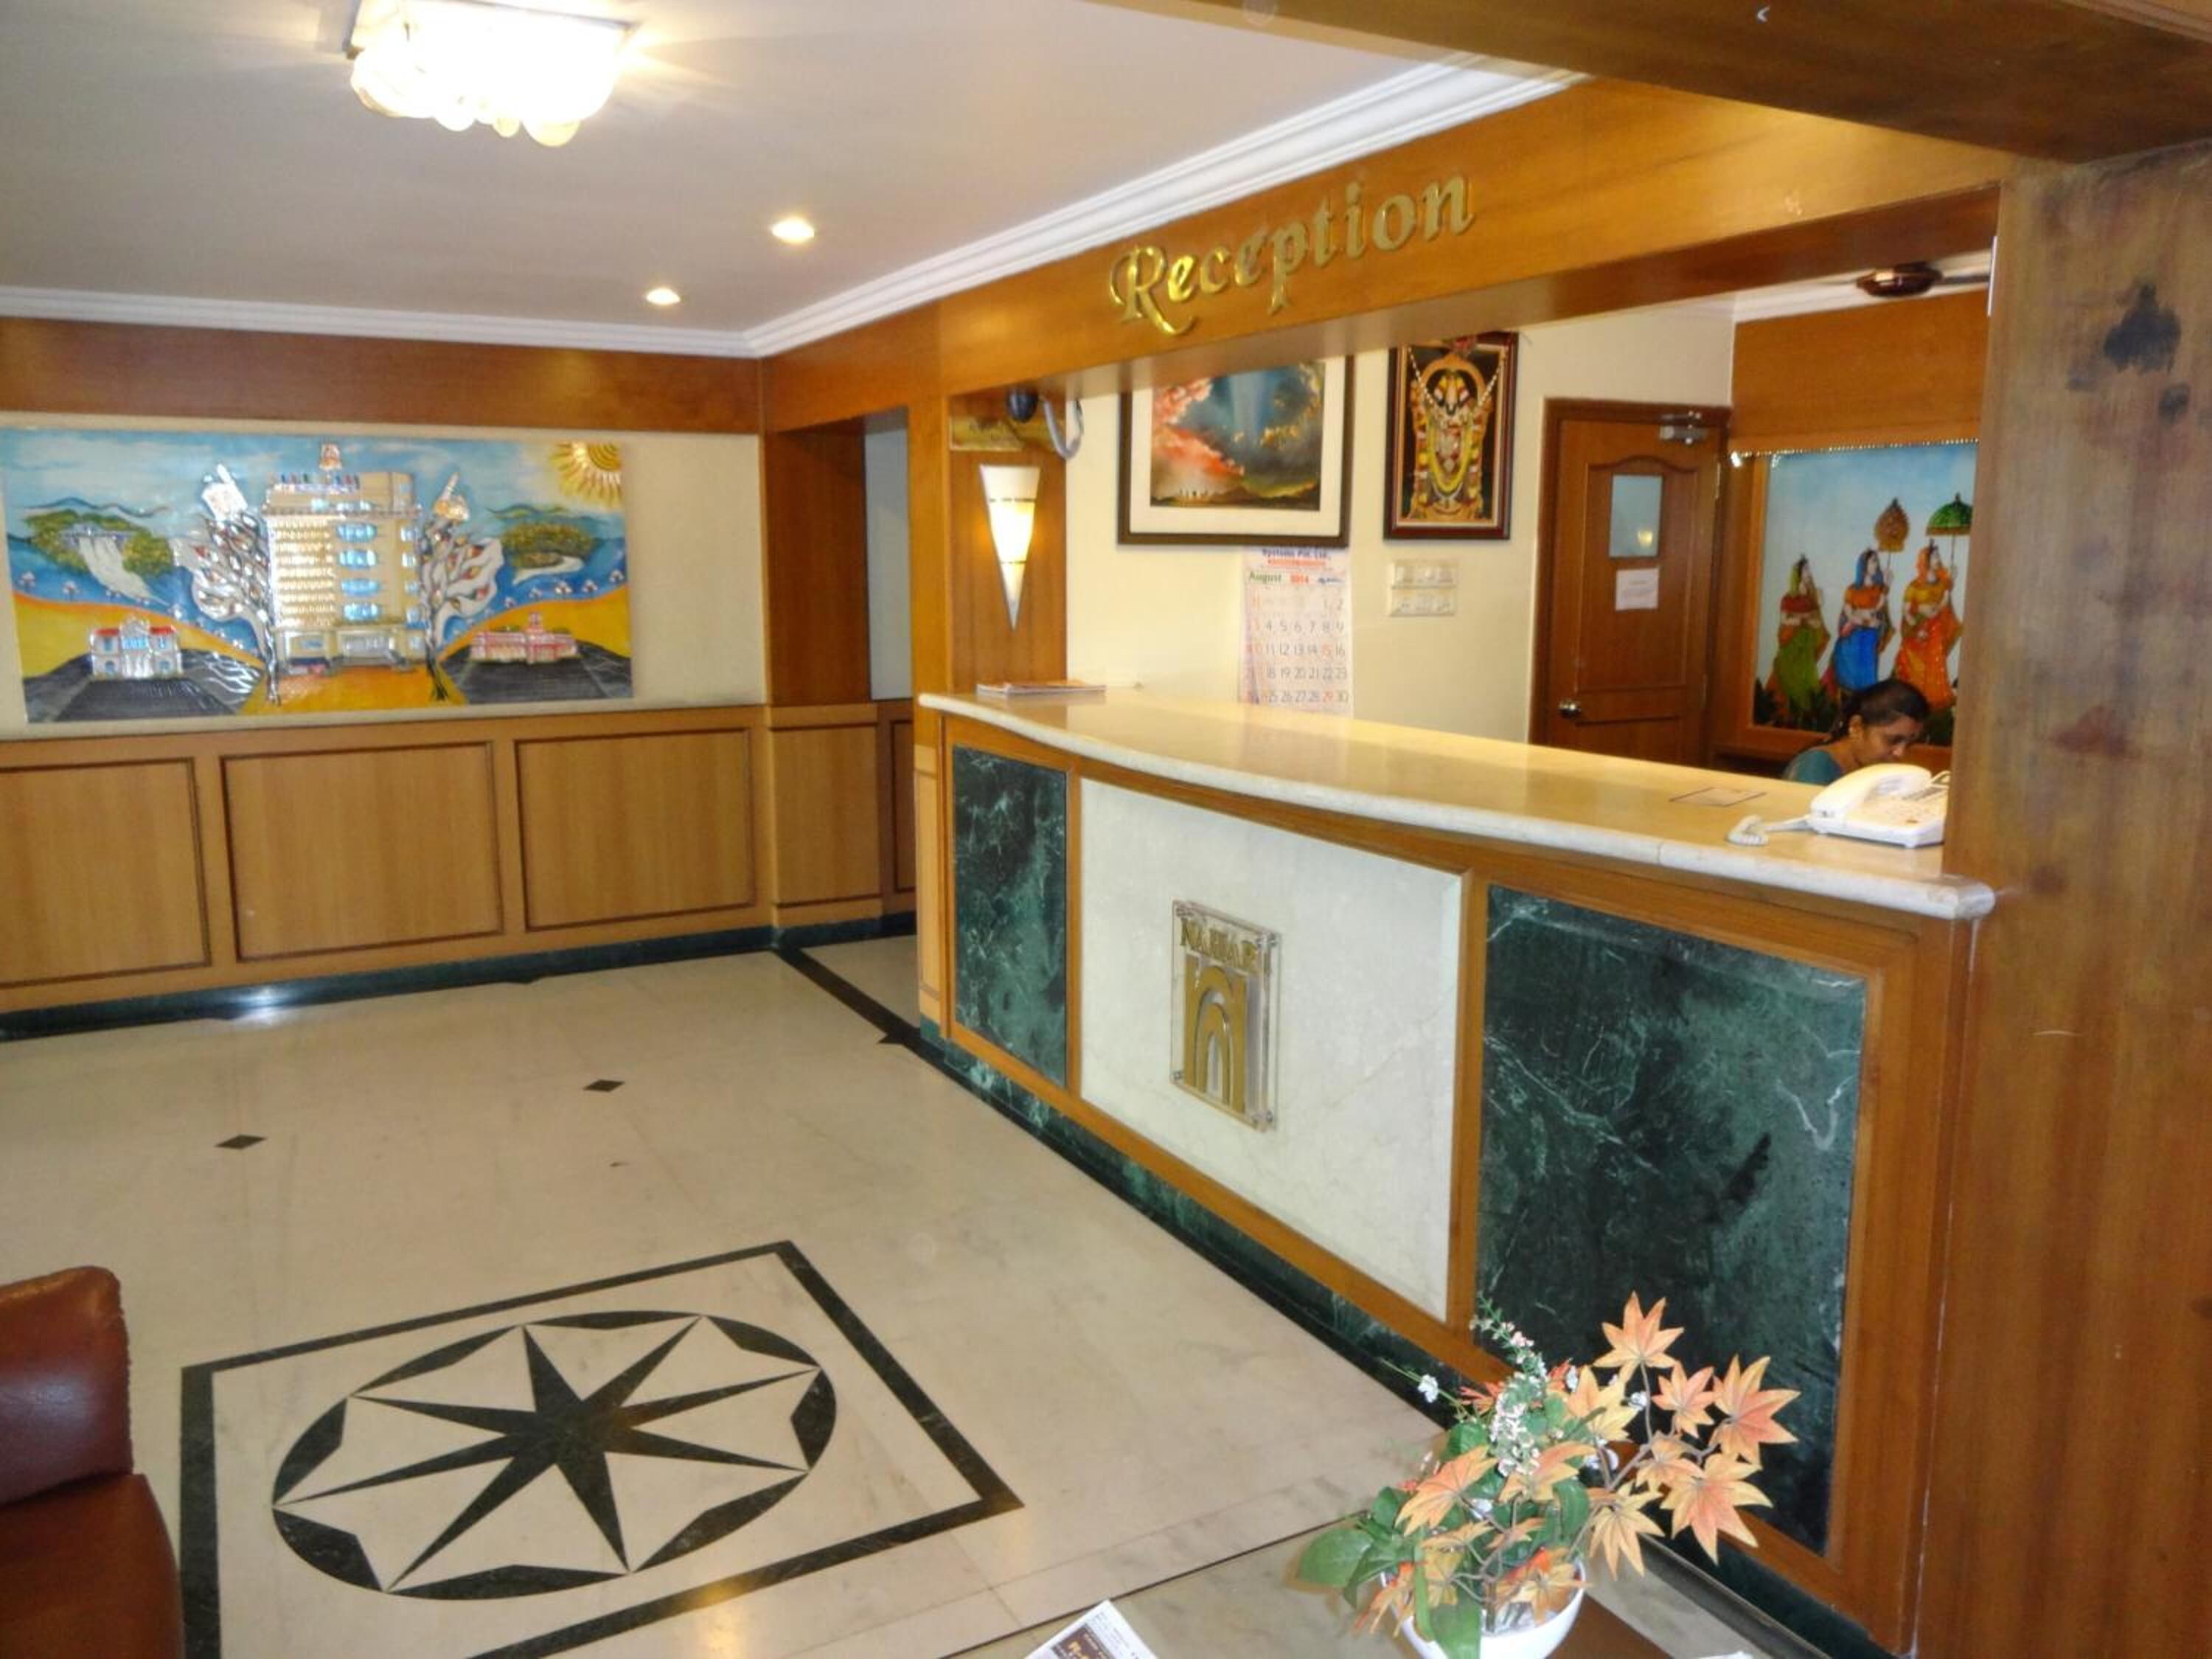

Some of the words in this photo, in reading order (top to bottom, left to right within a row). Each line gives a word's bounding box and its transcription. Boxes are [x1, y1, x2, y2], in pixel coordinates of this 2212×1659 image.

[1110, 174, 1475, 335] Reception
[1250, 571, 1282, 584] August
[1265, 620, 1272, 632] 4
[1280, 620, 1287, 632] 5
[1294, 620, 1302, 632] 6
[1309, 620, 1316, 632] 7
[1336, 620, 1344, 632] 9
[1265, 643, 1275, 655] 11
[1279, 643, 1290, 655] 12
[1294, 643, 1304, 655] 13
[1307, 643, 1318, 655] 14
[1335, 643, 1346, 655] 16
[1281, 667, 1290, 679] 19
[1293, 667, 1306, 679] 20
[1309, 667, 1319, 679] 21
[1322, 667, 1332, 679] 22
[1334, 667, 1347, 679] 23
